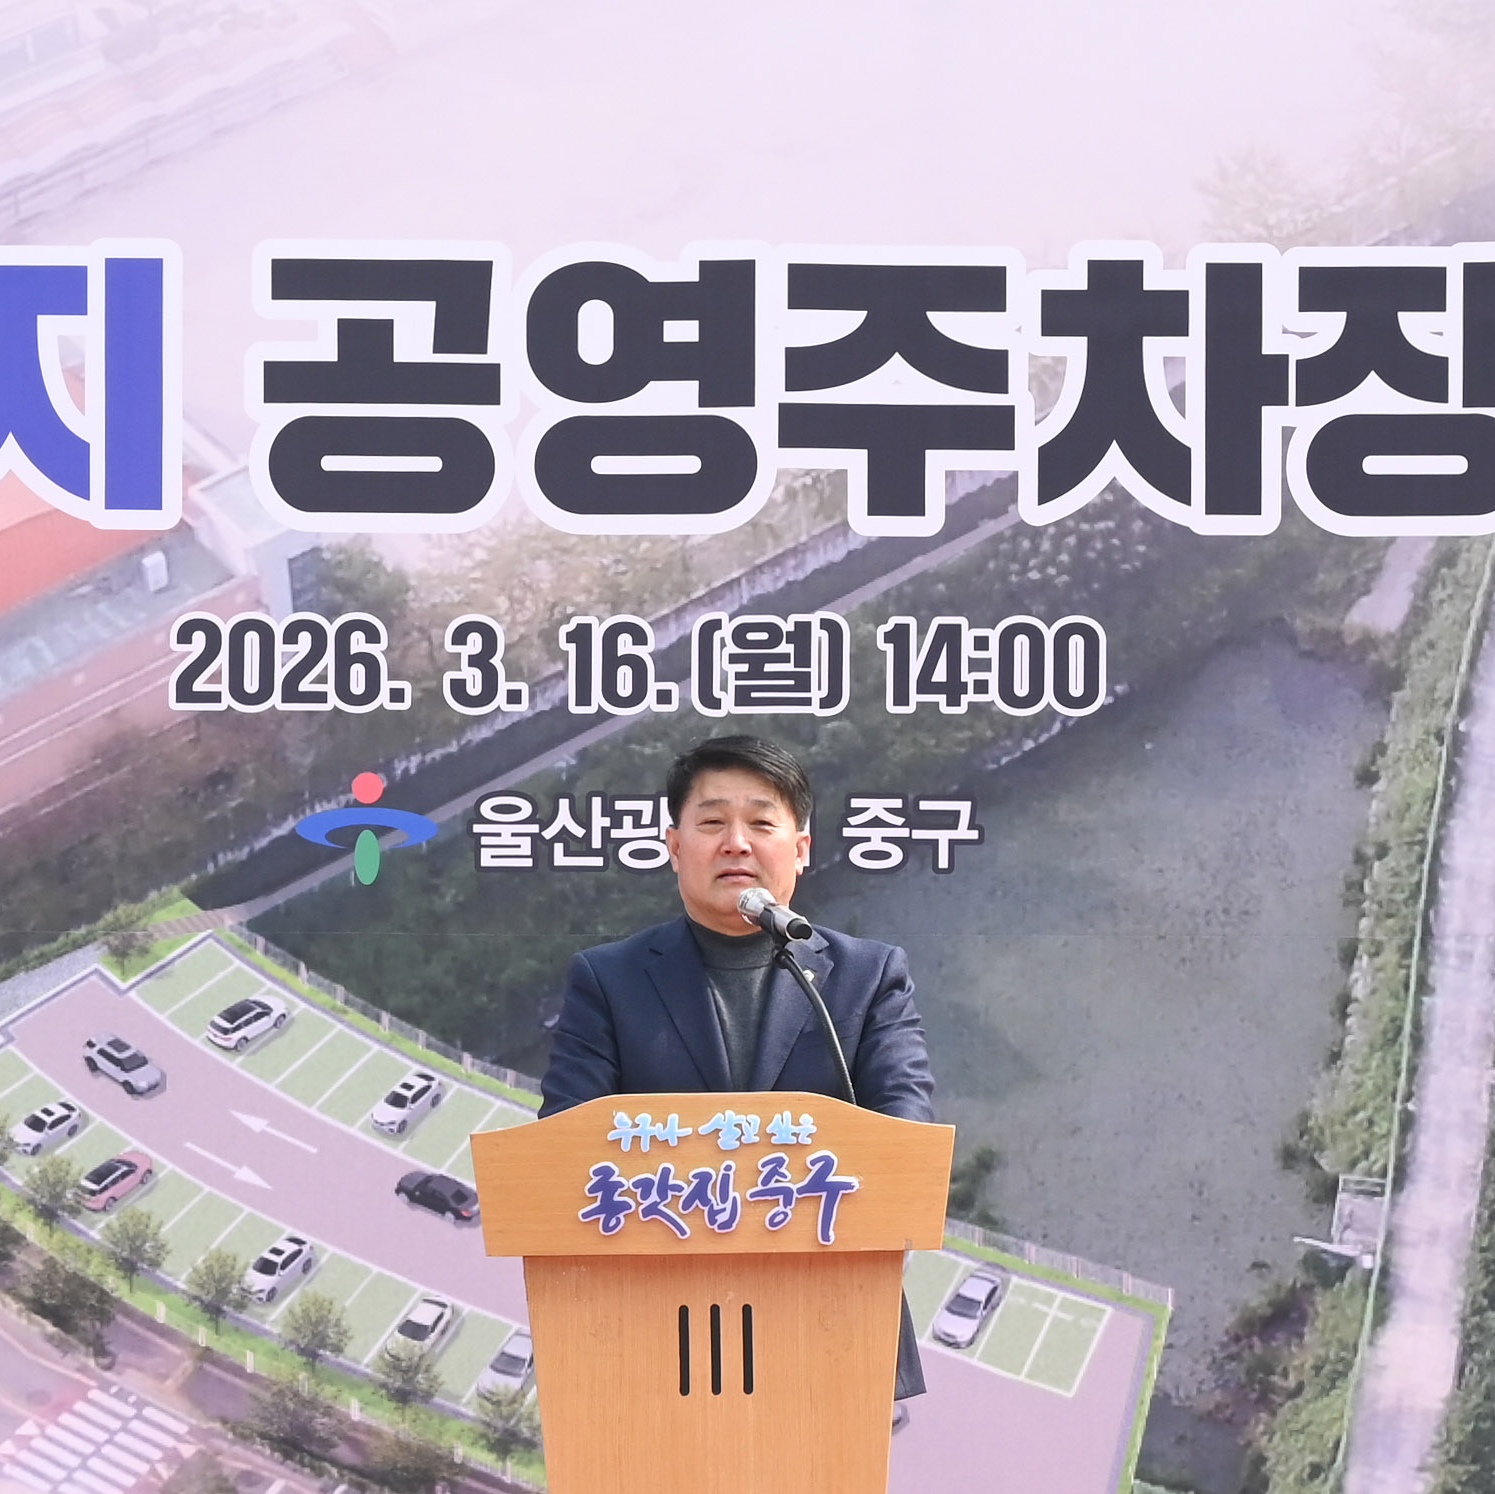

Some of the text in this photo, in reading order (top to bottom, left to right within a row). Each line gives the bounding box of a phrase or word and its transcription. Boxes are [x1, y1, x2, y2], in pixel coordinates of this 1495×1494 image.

[174, 620, 407, 709] 2026.
[449, 620, 522, 711] 3.
[884, 622, 1101, 713] 14:00
[472, 795, 980, 869] 울산광 중구
[608, 1110, 818, 1152] 누구나 살고 싶은
[579, 1152, 859, 1244] 종갓집 중구
